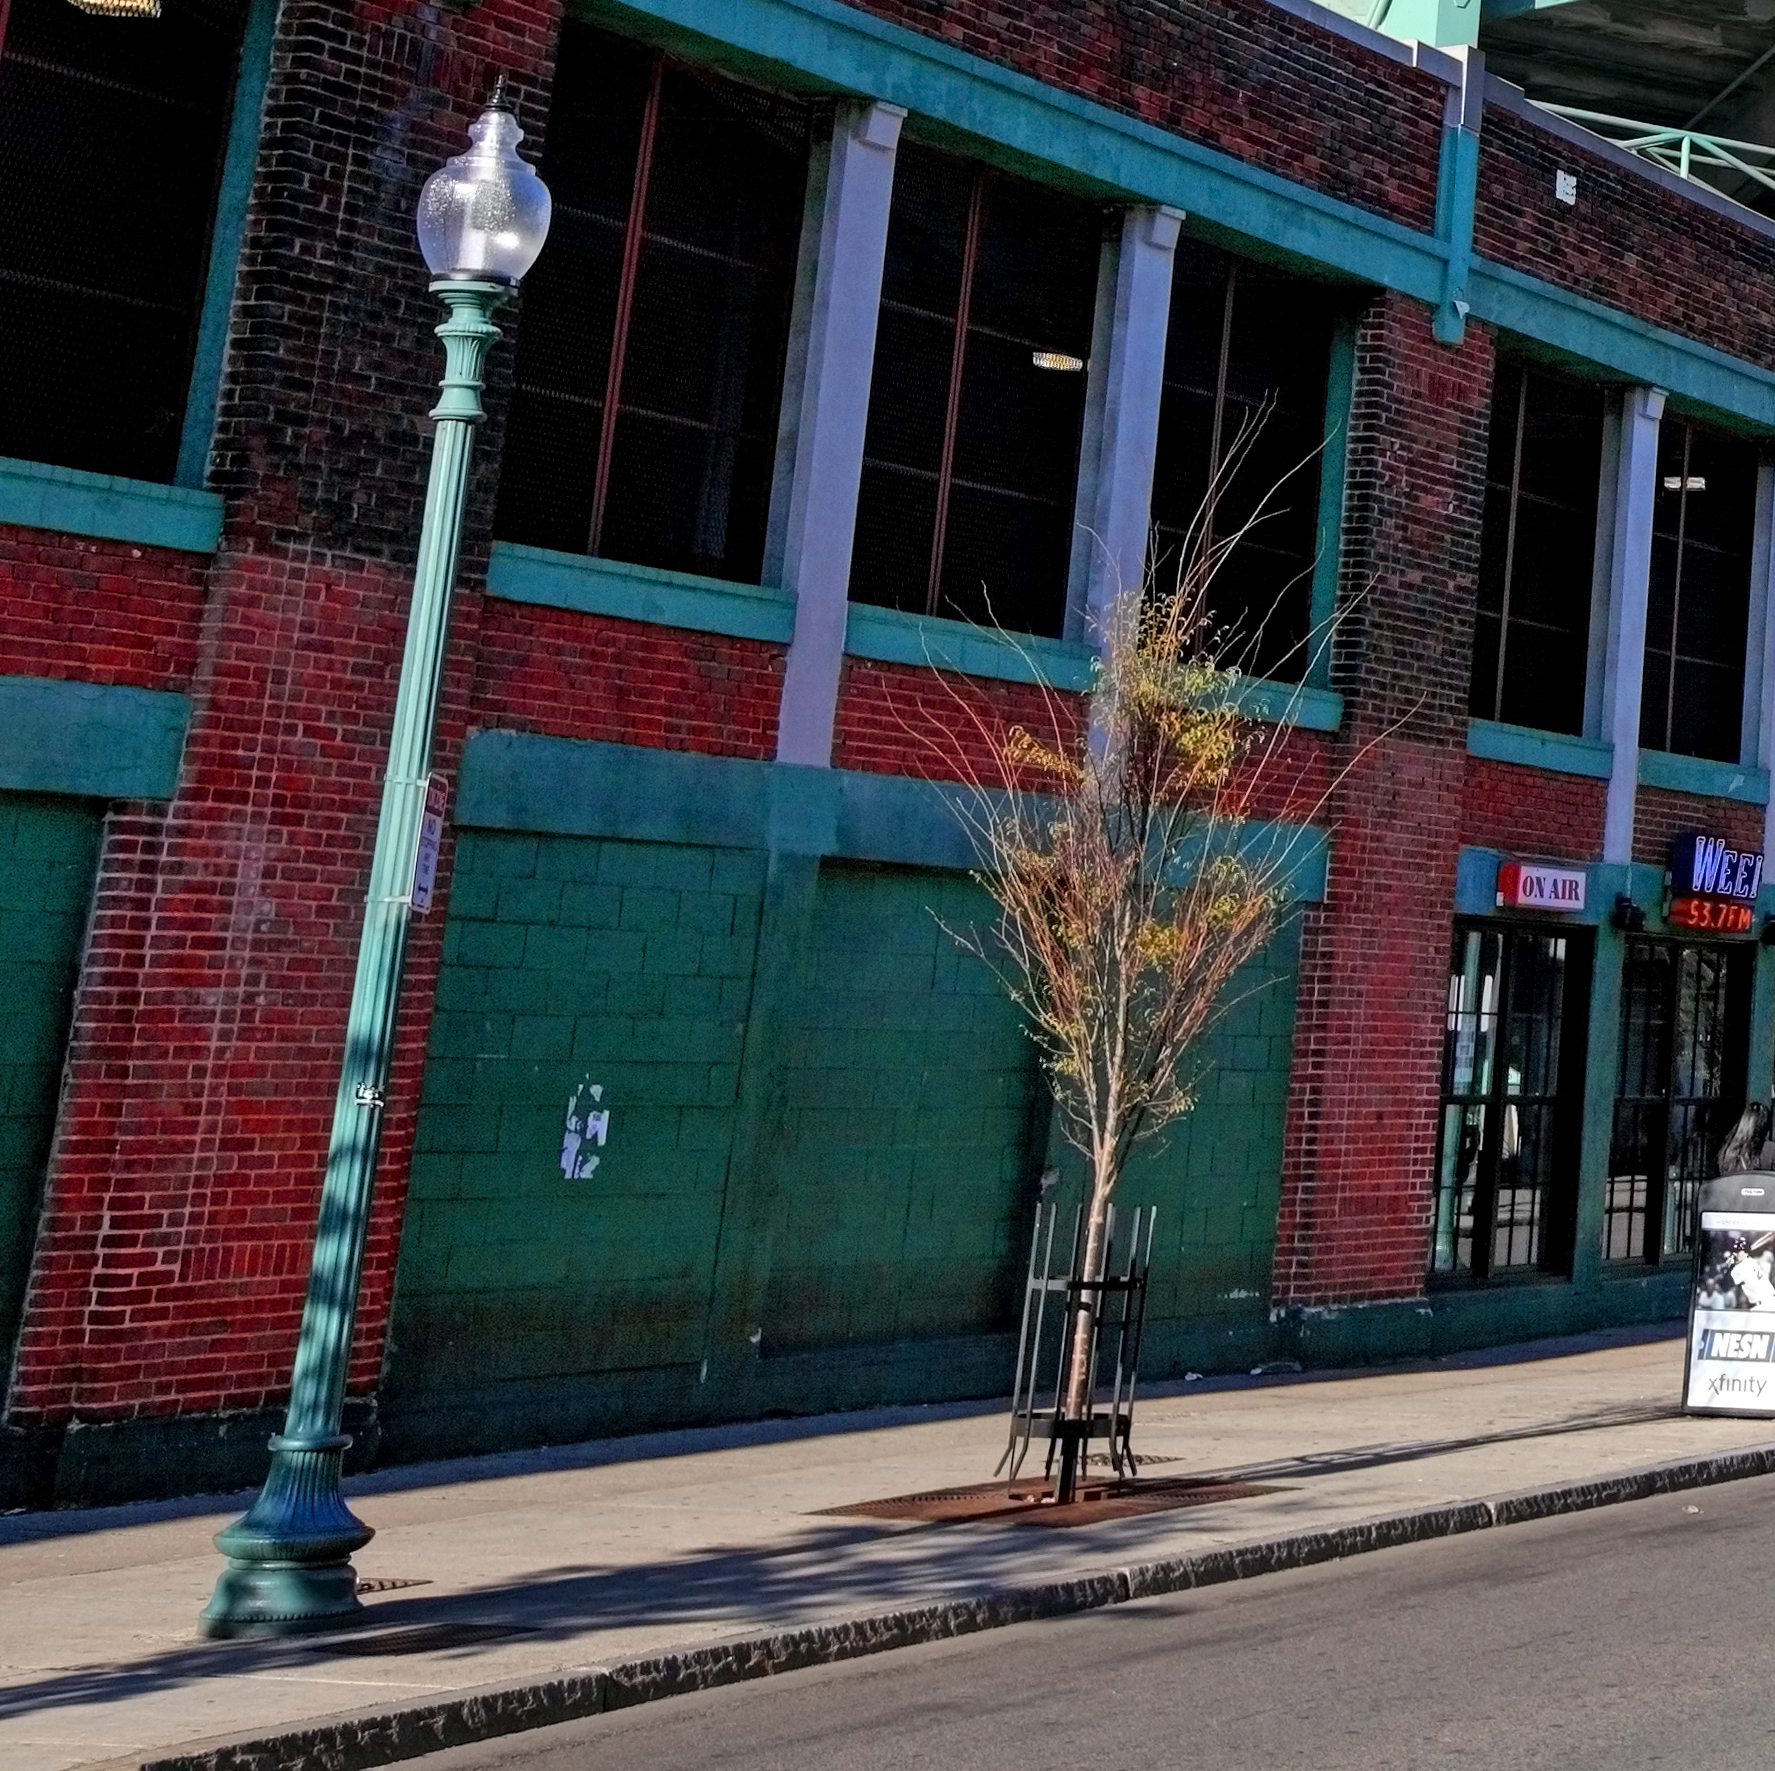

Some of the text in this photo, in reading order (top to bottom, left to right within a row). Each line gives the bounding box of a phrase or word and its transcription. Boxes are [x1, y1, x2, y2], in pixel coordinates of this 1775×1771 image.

[1692, 834, 1763, 899] WEEI
[1522, 874, 1581, 902] ON AIR
[1710, 1332, 1770, 1360] NESN
[1708, 1373, 1768, 1397] xfinity
